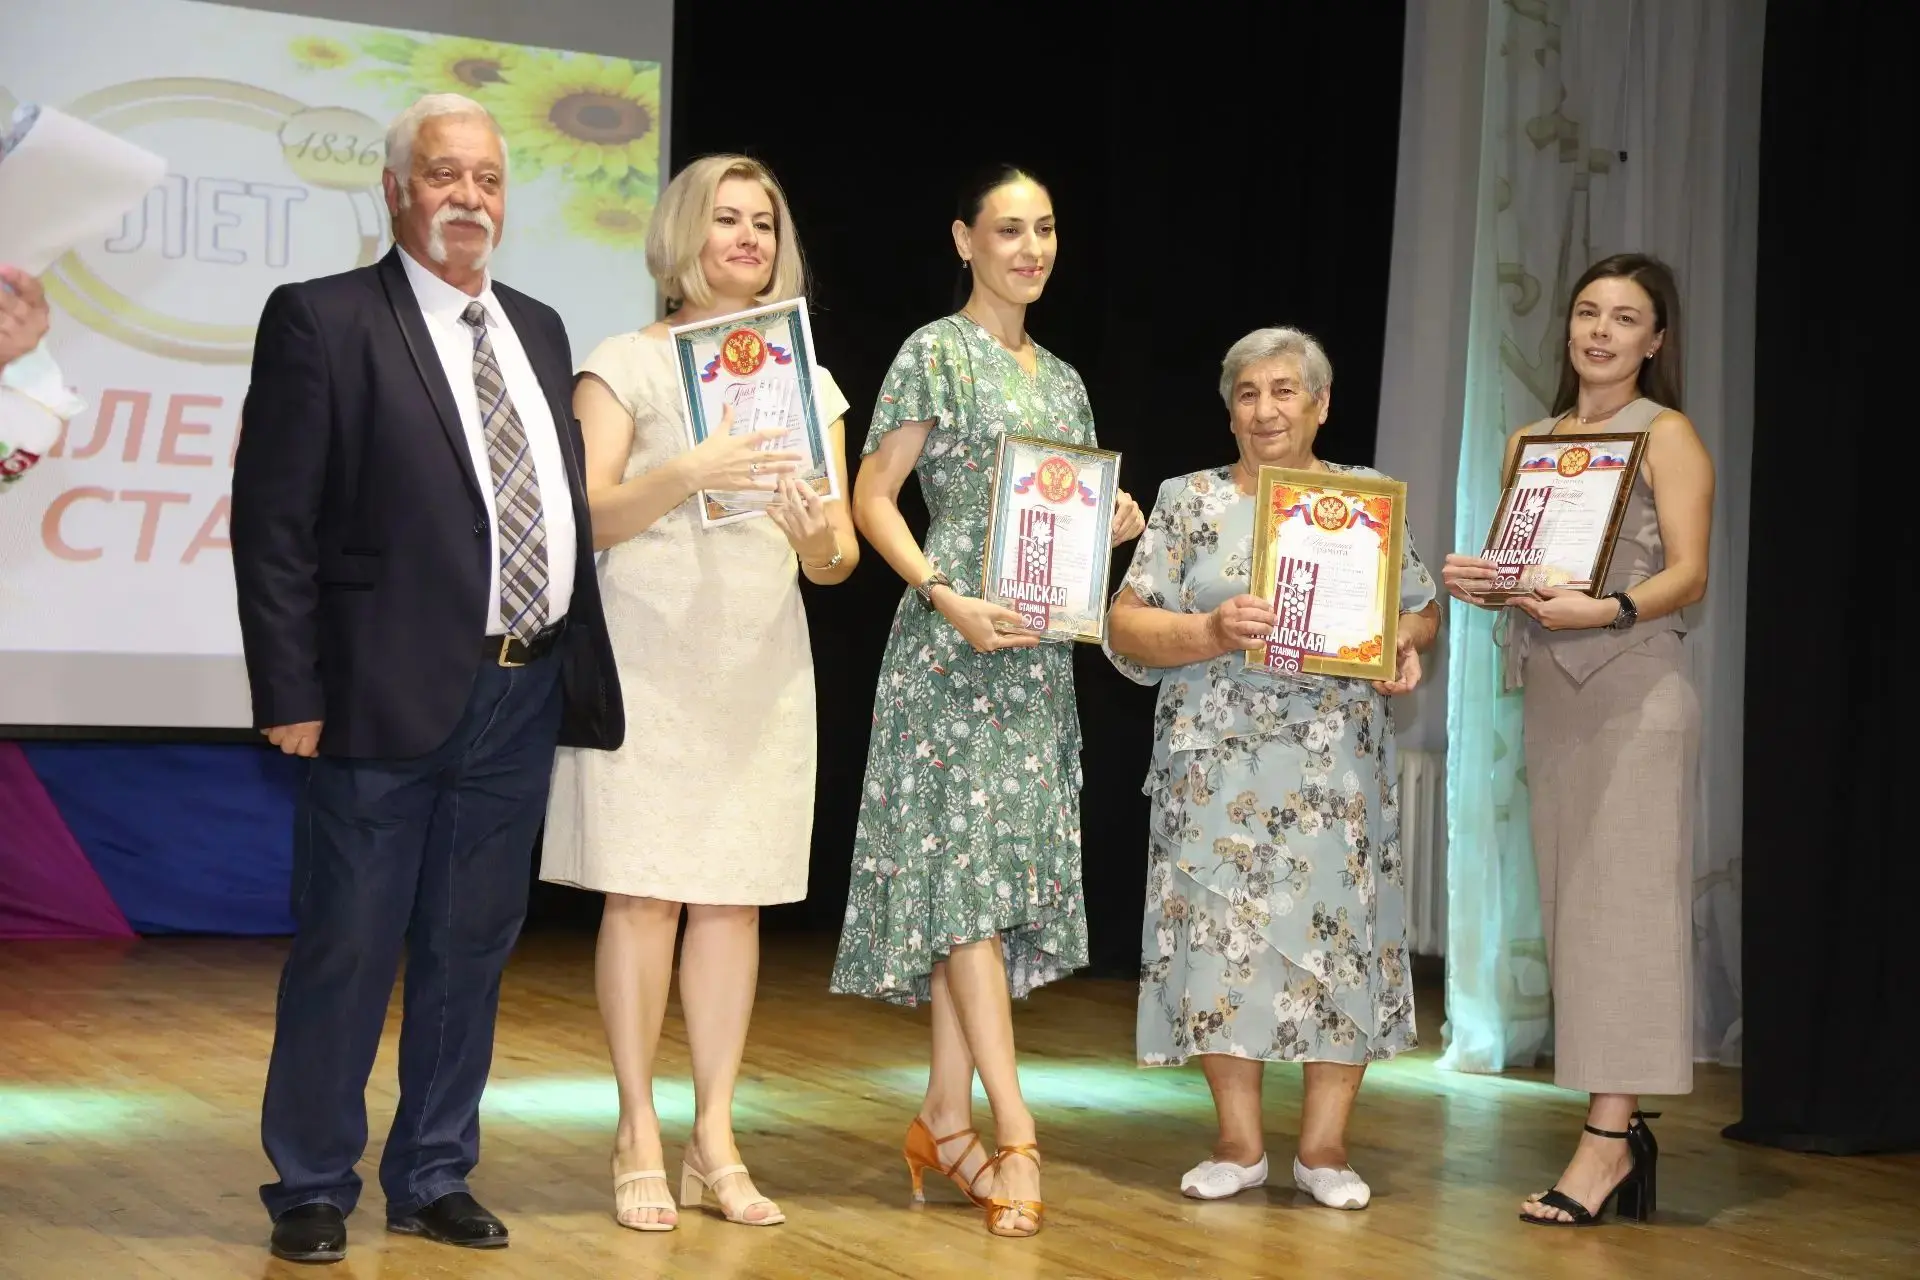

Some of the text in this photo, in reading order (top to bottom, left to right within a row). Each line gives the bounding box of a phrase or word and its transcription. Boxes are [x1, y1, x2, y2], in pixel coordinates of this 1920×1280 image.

[294, 130, 384, 167] 1836
[104, 173, 310, 269] ЛЕТ
[47, 388, 243, 469] ЛЕ
[1496, 566, 1520, 575] ТАНИЦА
[1000, 579, 1067, 607] АНАПСКАЯ
[1018, 602, 1046, 615] СТАНИЦА
[1251, 626, 1326, 653] АПСКАЯ
[1270, 645, 1300, 659] СТАНИЦА
[1269, 655, 1298, 674] 190
